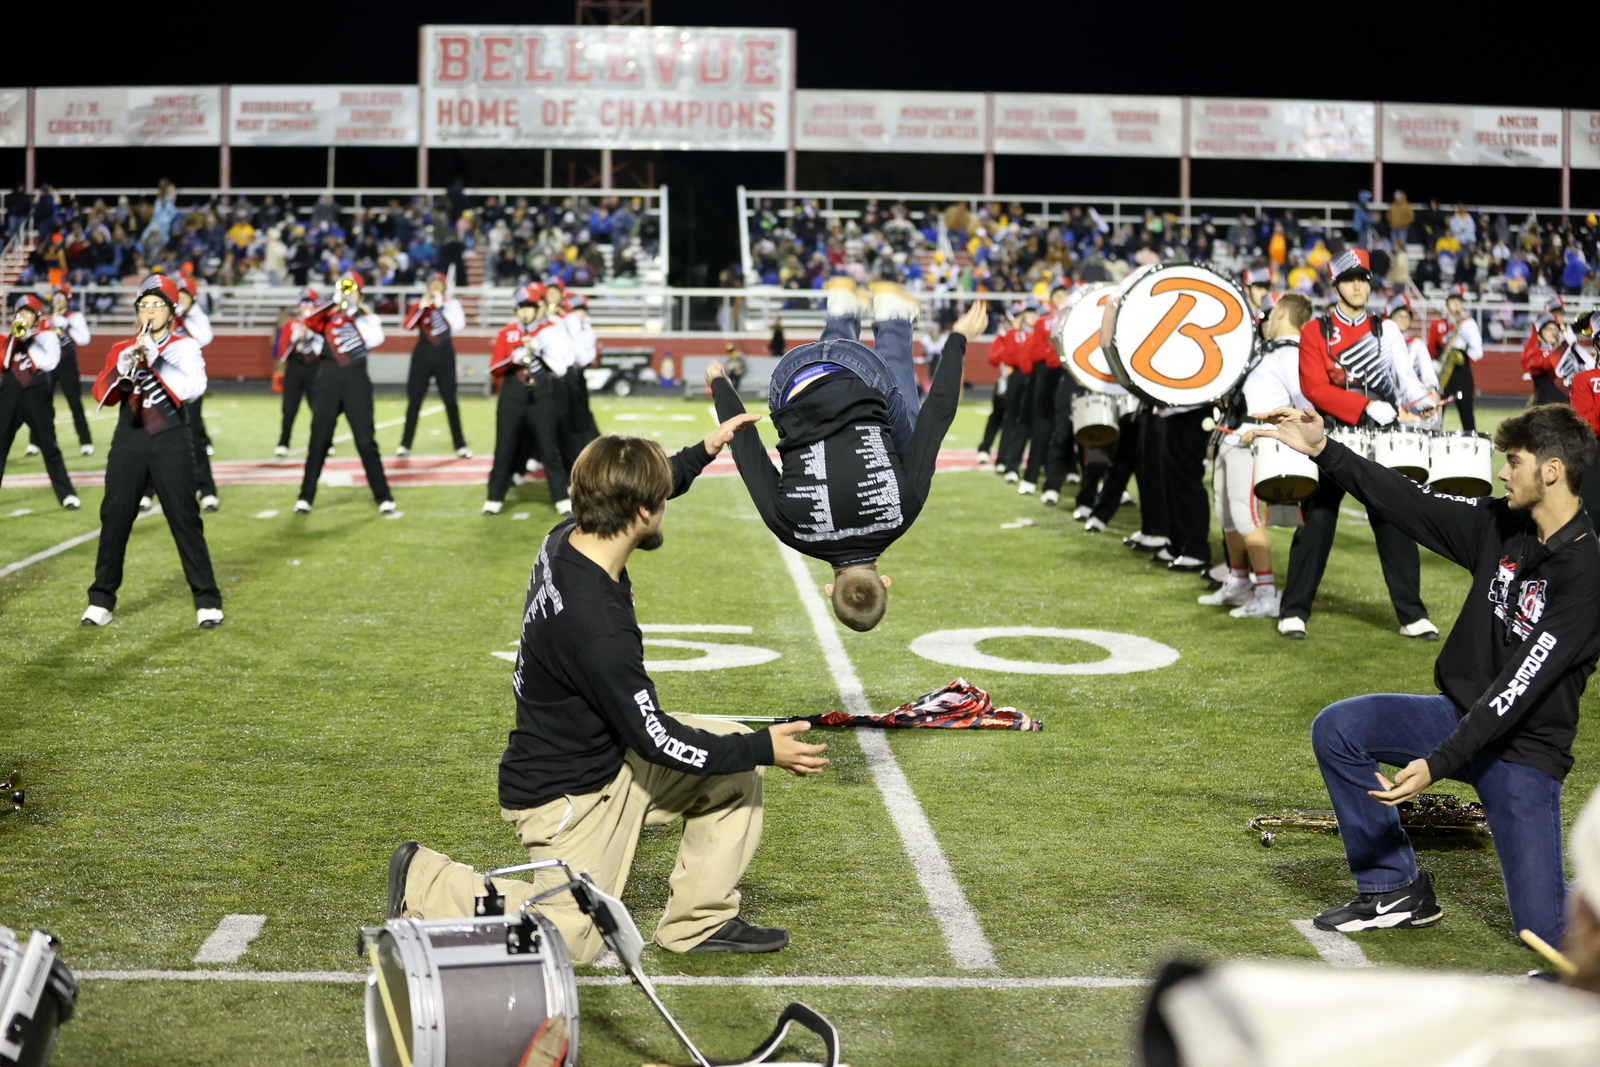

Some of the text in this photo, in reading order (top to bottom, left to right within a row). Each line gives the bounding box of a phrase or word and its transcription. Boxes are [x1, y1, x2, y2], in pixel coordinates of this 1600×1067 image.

[436, 35, 779, 87] BELLEVUE
[437, 98, 519, 127] HOME
[541, 99, 577, 127] OF
[600, 100, 777, 130] CHAMPIONS
[1475, 131, 1539, 147] BELLEVUE
[1130, 276, 1244, 390] B
[1488, 631, 1558, 717] BOREMAN
